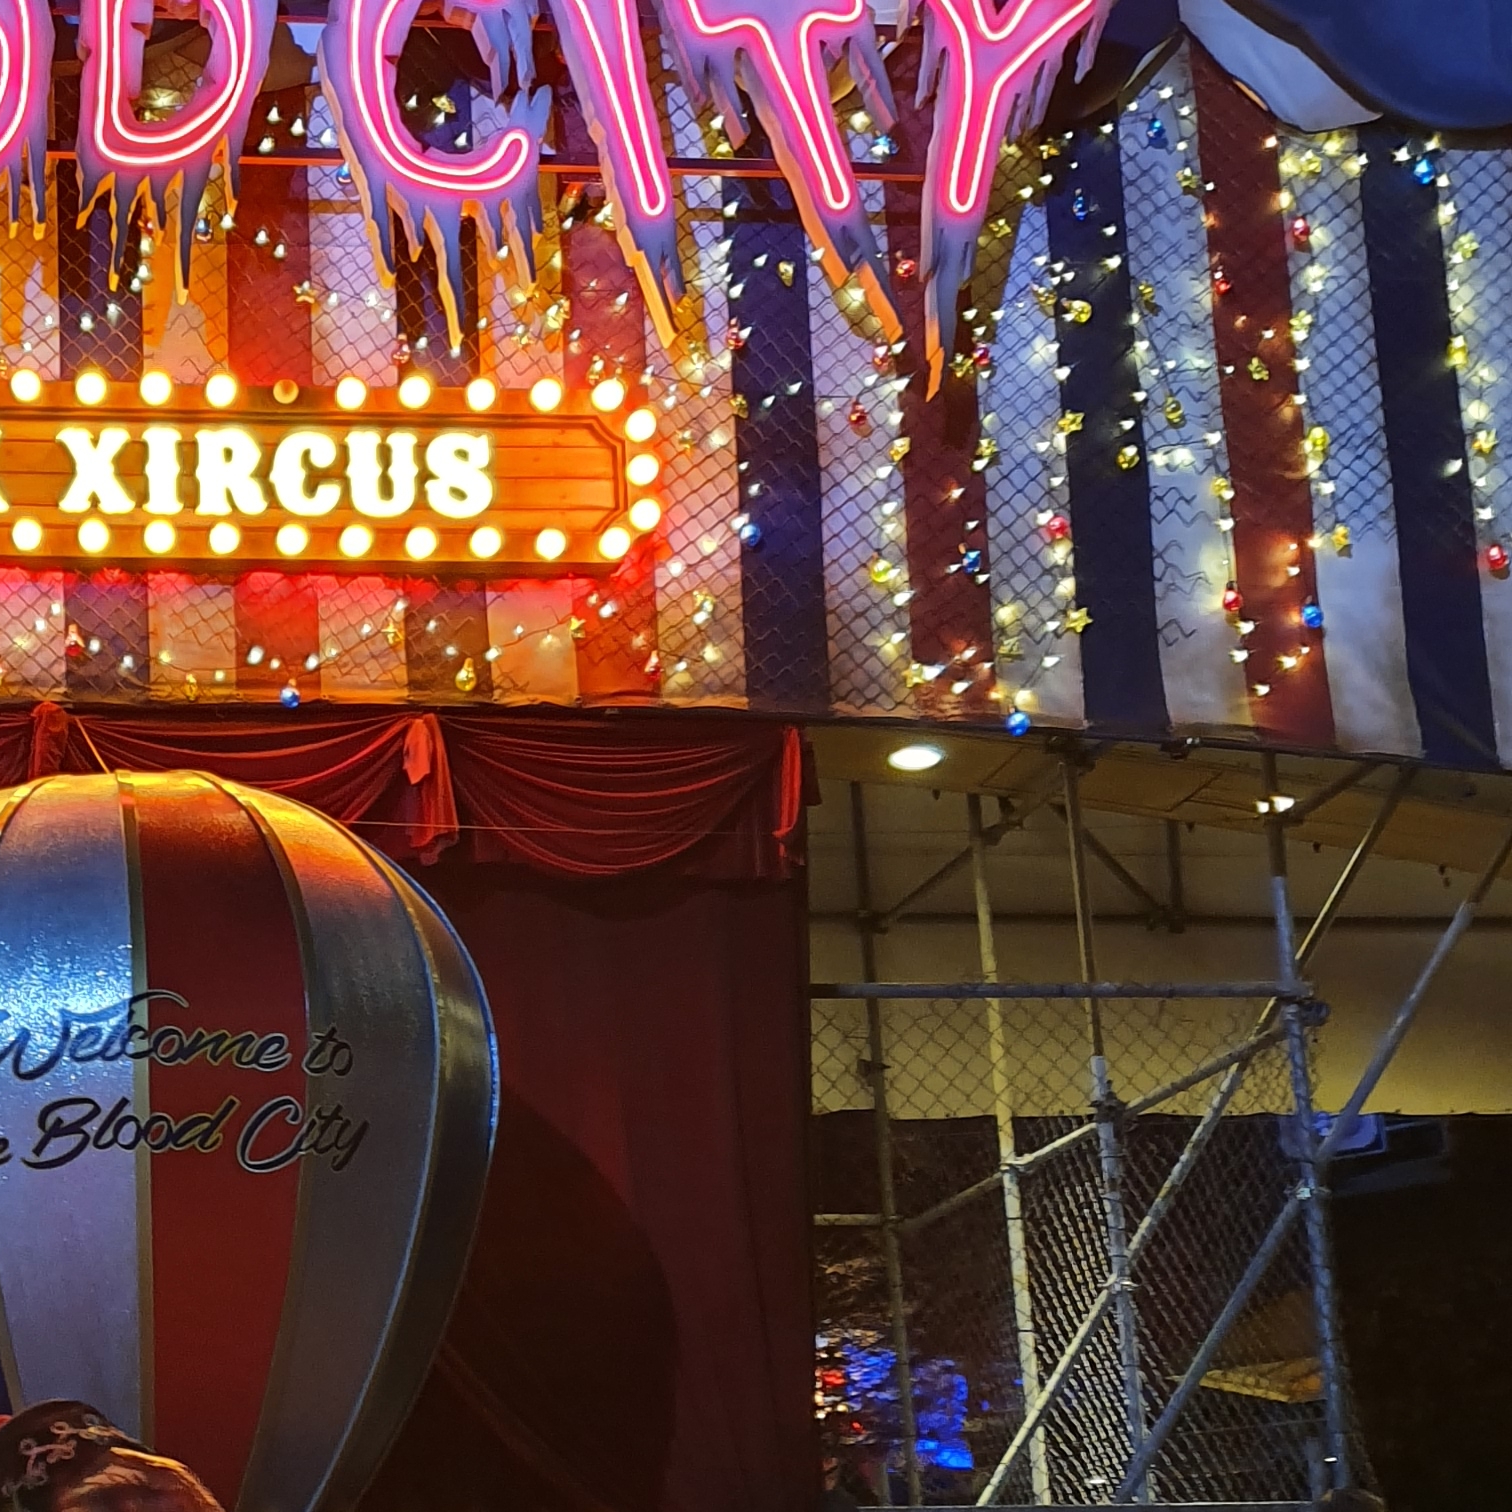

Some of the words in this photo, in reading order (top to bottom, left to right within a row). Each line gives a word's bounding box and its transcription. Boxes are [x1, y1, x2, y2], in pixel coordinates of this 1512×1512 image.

[56, 427, 494, 519] XIRCUS
[302, 1026, 354, 1077] to
[21, 1096, 241, 1171] Blood
[237, 1096, 370, 1173] City
